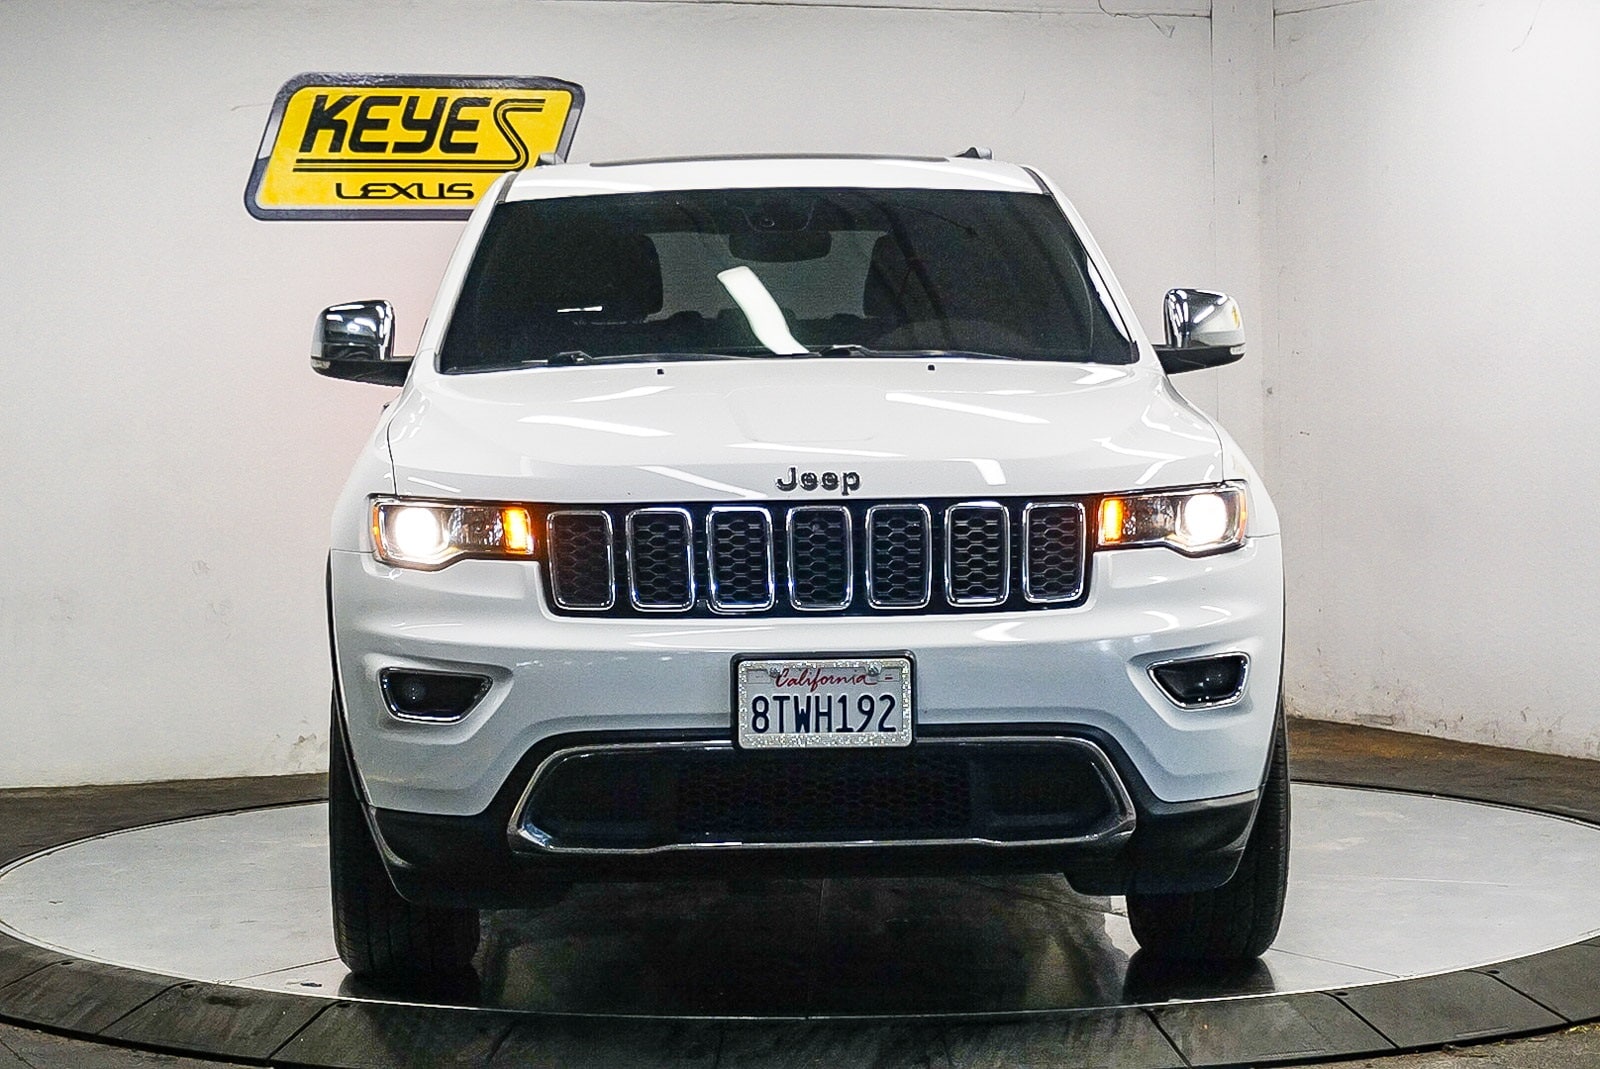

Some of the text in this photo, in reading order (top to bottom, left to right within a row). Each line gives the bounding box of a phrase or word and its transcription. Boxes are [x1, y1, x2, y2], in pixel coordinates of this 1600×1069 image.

[296, 94, 546, 171] KEYES
[335, 182, 475, 200] LEXUS
[776, 467, 861, 496] Jeep
[775, 667, 878, 692] California
[751, 694, 896, 734] 8TWH192
